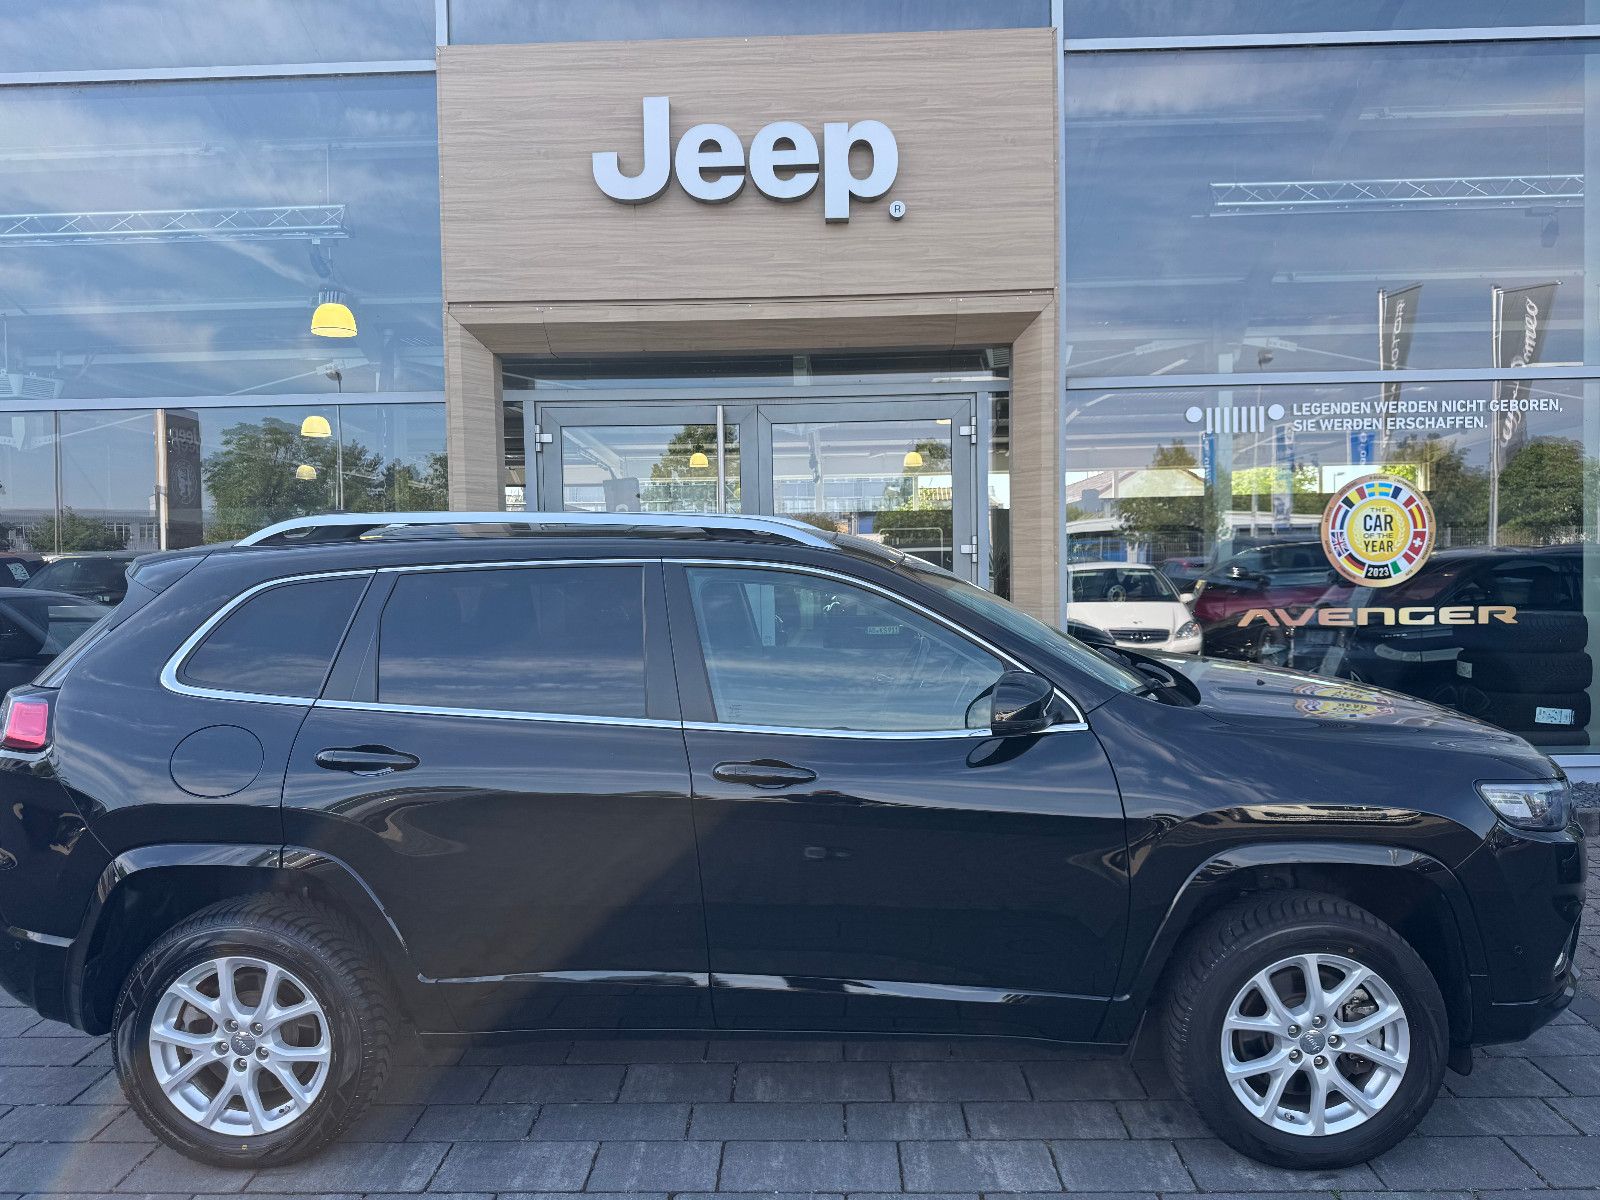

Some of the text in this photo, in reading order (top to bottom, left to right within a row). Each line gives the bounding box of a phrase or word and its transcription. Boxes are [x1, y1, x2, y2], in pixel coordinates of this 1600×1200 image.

[592, 96, 899, 222] Jeep
[1293, 398, 1563, 416] LEGENDEN WERDEN NICHT GEBOREN,
[1293, 416, 1488, 432] SIE WERDEN ERSCHAFFEN.
[1363, 514, 1394, 532] CAR
[1363, 540, 1394, 553] YEAR
[1366, 566, 1390, 577] 2023
[1237, 605, 1519, 627] AVENGER
